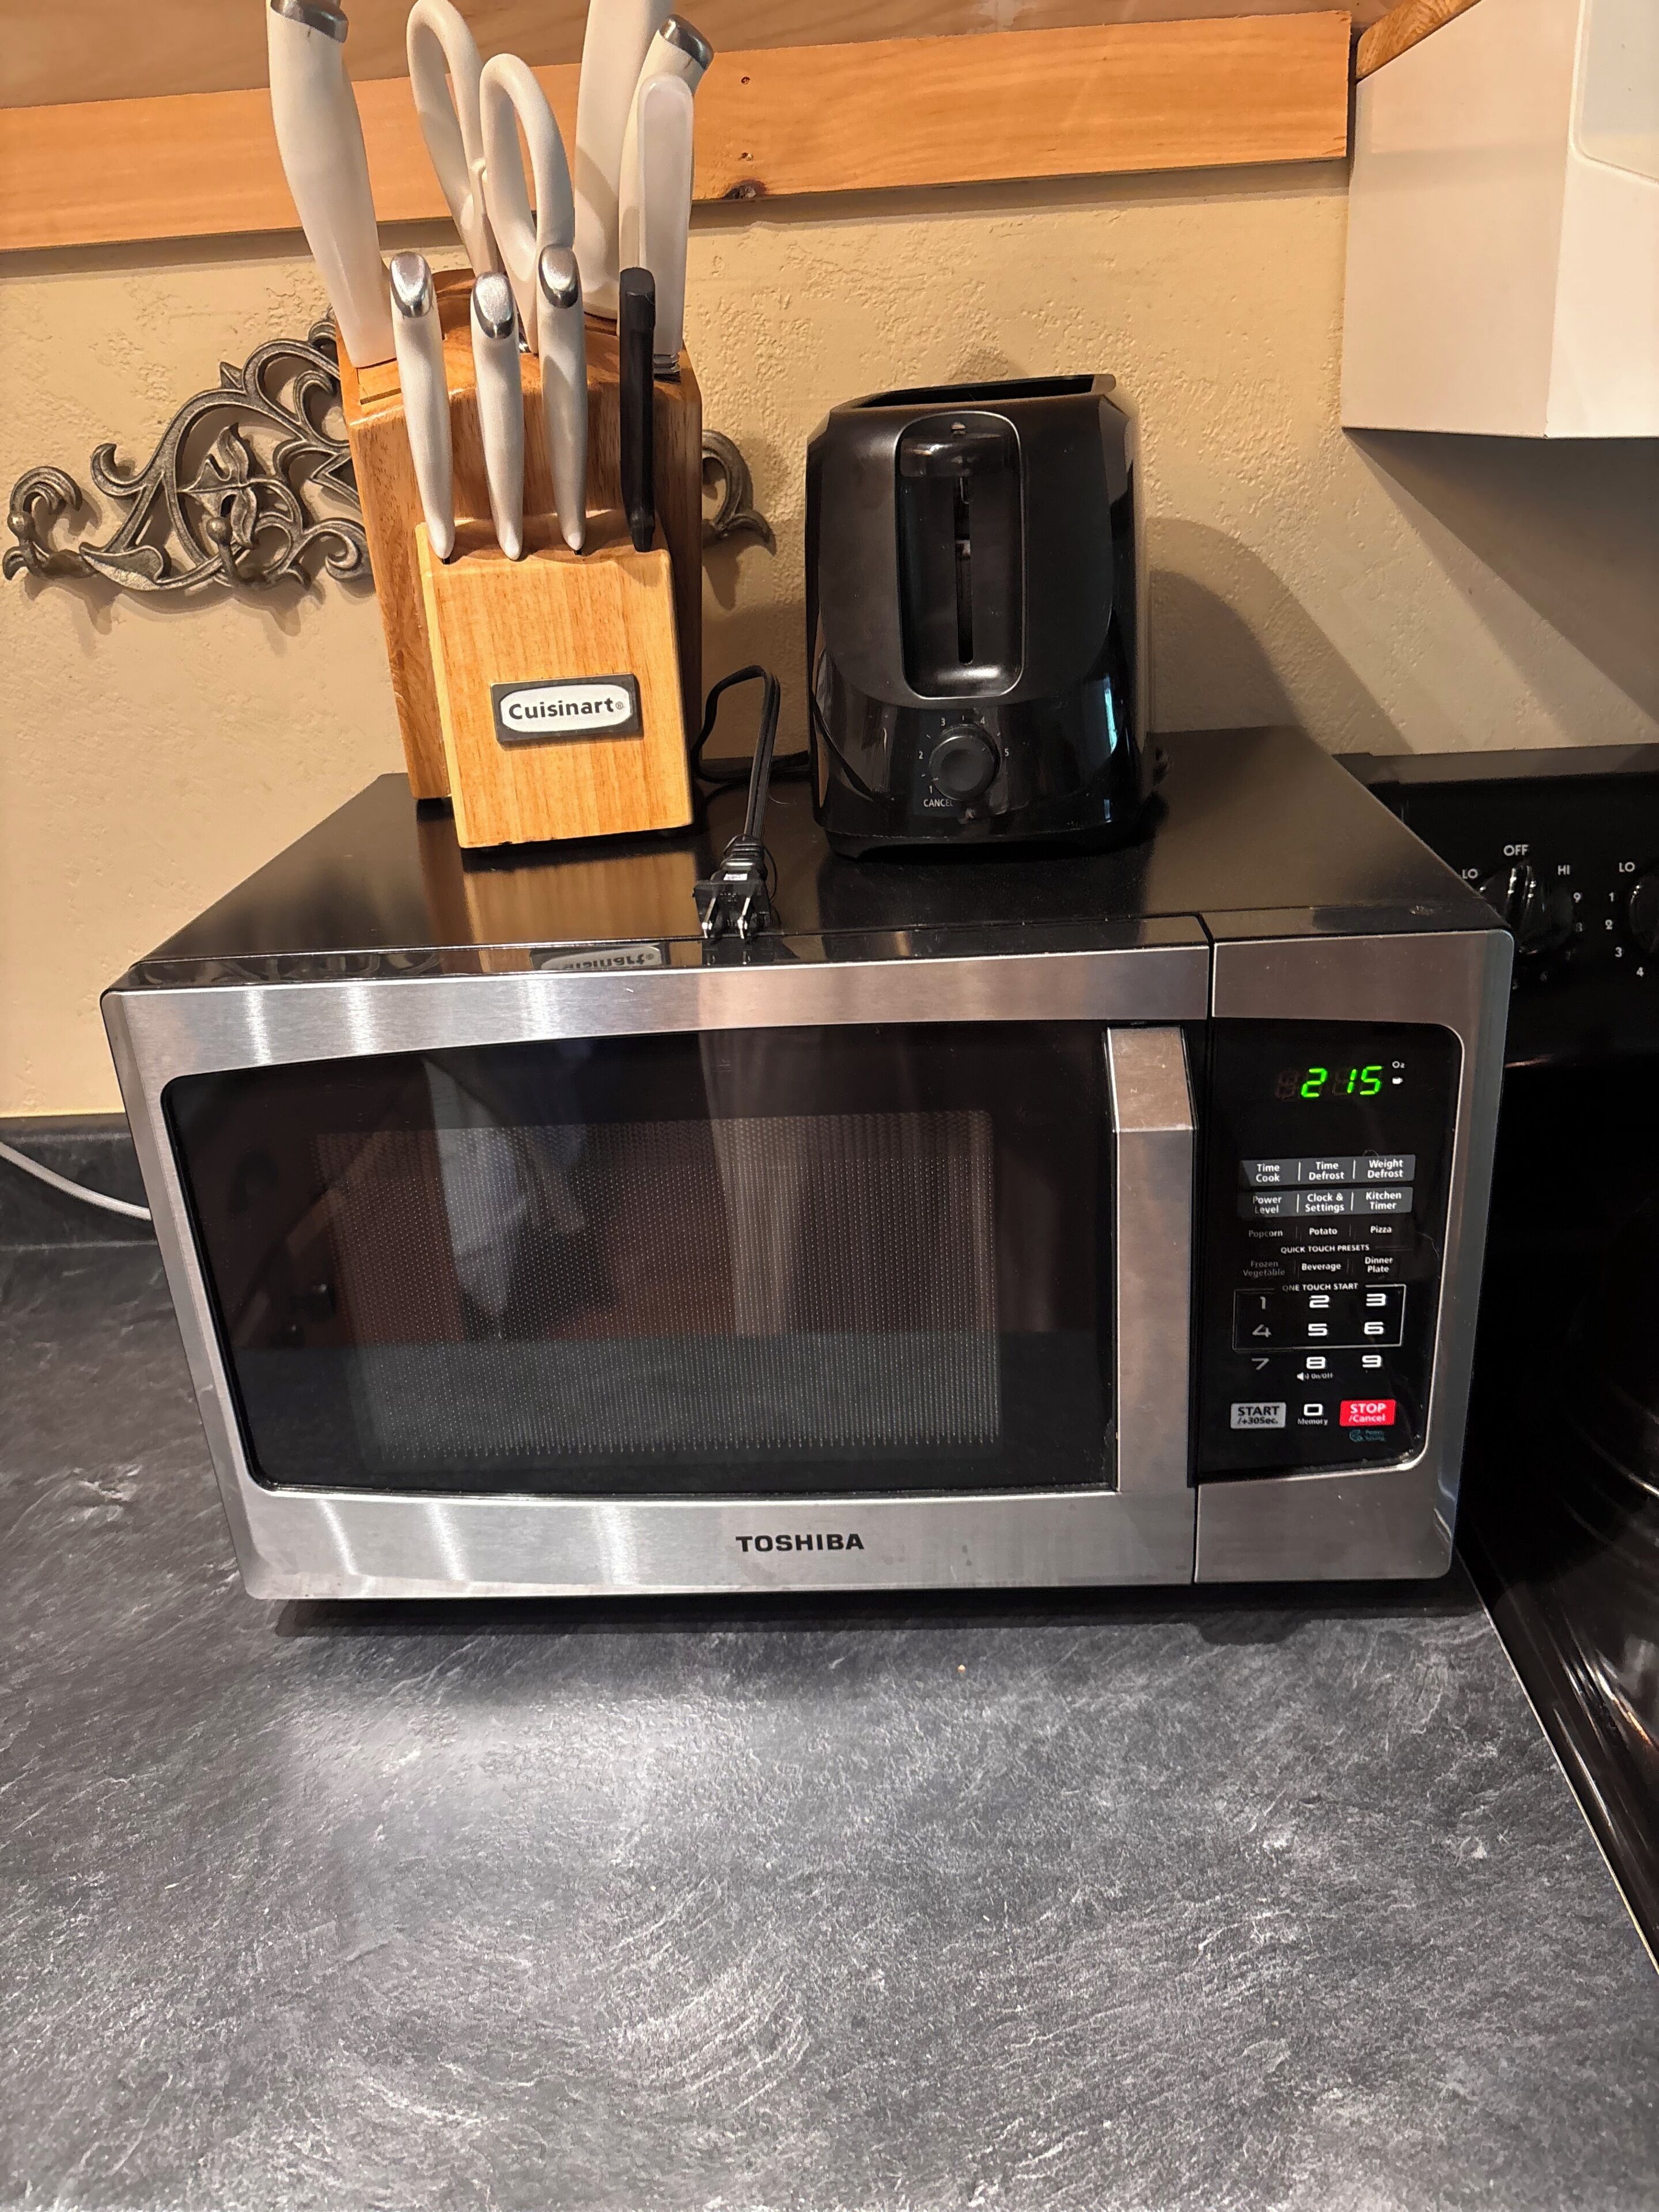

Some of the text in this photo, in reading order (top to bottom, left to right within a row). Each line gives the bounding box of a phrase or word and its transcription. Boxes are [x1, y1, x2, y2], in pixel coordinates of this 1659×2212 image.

[941, 718, 945, 726] 3
[923, 799, 953, 807] CANCEL
[1503, 844, 1528, 856] OFF
[1558, 865, 1570, 875] HI
[1619, 862, 1635, 872] LO
[1462, 869, 1478, 880] LO
[1573, 893, 1581, 903] 9
[1609, 893, 1613, 902] 1
[1605, 920, 1612, 930] 2
[1615, 947, 1622, 957] 3
[1637, 967, 1643, 976] 4
[1257, 1164, 1279, 1172] Time
[1316, 1161, 1339, 1170] Time
[1369, 1160, 1403, 1169] Weight
[1256, 1174, 1280, 1182] Cook
[1309, 1172, 1344, 1180] Defrost
[1368, 1169, 1403, 1178] Defrost
[1253, 1196, 1282, 1204] Power
[1307, 1193, 1343, 1202] Clock &
[1366, 1191, 1402, 1200] Kitchen
[1255, 1206, 1278, 1214] Level
[1305, 1203, 1344, 1213] Settings
[1370, 1202, 1396, 1210] Timer
[1248, 1229, 1283, 1238] Popcorn
[1309, 1227, 1338, 1235] Potato
[1370, 1225, 1392, 1233] Pizza
[1281, 1246, 1306, 1254] QUICK
[1301, 1263, 1341, 1271] Beverage
[1243, 1269, 1285, 1278] Vegetable
[1260, 1294, 1386, 1309] 1 2 3
[1252, 1321, 1384, 1337] 4 5 6
[1251, 1355, 1382, 1370] 7 8 9
[1238, 1406, 1279, 1416] START
[1350, 1403, 1387, 1414] STOP
[1349, 1414, 1385, 1422] /Cancel
[736, 1533, 864, 1552] TOSHIBA
